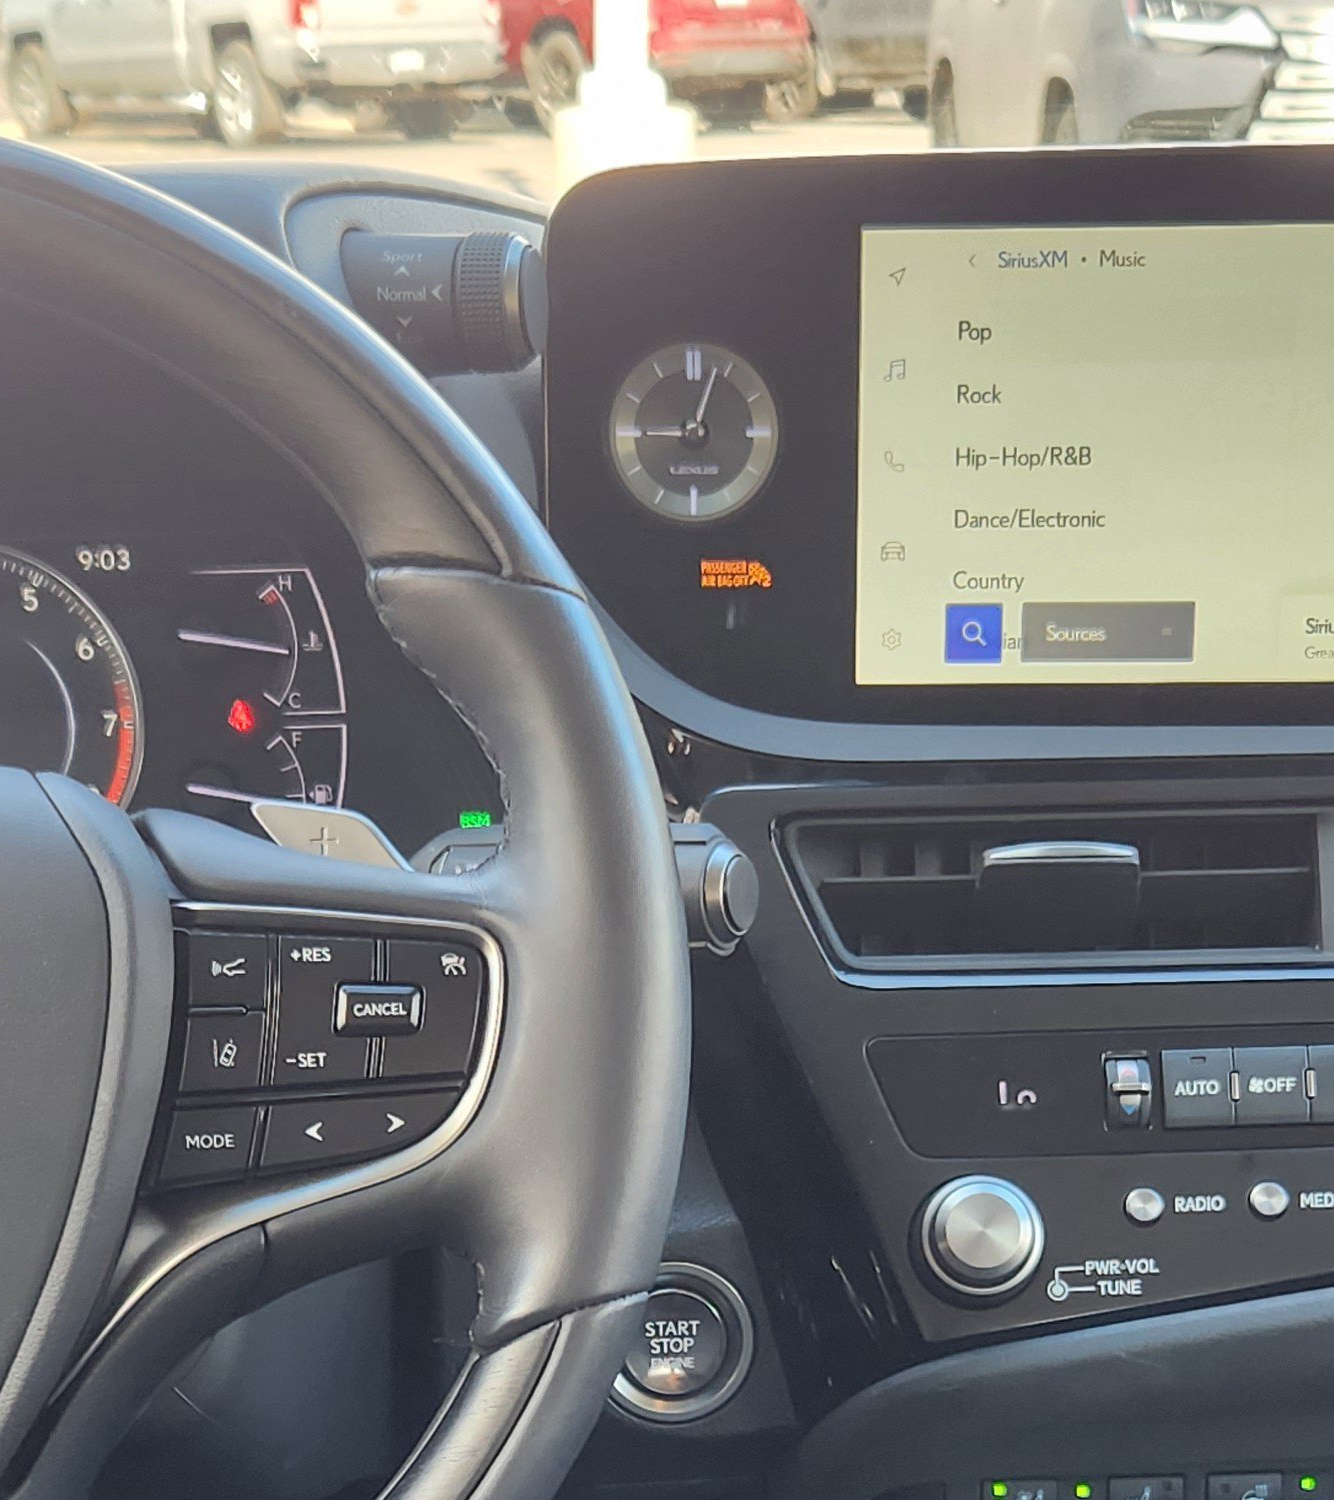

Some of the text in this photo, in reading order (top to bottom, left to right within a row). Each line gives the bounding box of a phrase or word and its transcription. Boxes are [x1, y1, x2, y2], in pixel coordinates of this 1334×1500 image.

[381, 250, 424, 265] Sport
[998, 250, 1147, 268] SiriusXM Music
[376, 285, 427, 302] Normal
[957, 321, 993, 344] Pop
[956, 384, 1003, 405] Rock
[955, 446, 1093, 470] Hip-Hop/R&B
[954, 508, 1107, 531] Dance/Electronic
[76, 547, 131, 571] 9:03
[277, 575, 292, 592] H
[952, 570, 1025, 593] Country
[21, 585, 39, 612] 5
[1045, 622, 1107, 643] Sources
[76, 635, 95, 661] 6
[288, 692, 302, 709] C
[101, 711, 118, 737] 7
[291, 732, 303, 748] F
[352, 1002, 408, 1018] CANCEL
[1174, 1078, 1220, 1096] AUTO
[1262, 1076, 1298, 1093] OFF
[185, 1133, 236, 1150] MODE
[1174, 1195, 1227, 1213] RADIO
[1097, 1279, 1143, 1296] TUNE
[644, 1319, 701, 1338] START
[649, 1337, 696, 1355] STOP
[650, 1356, 696, 1369] ENGINE
